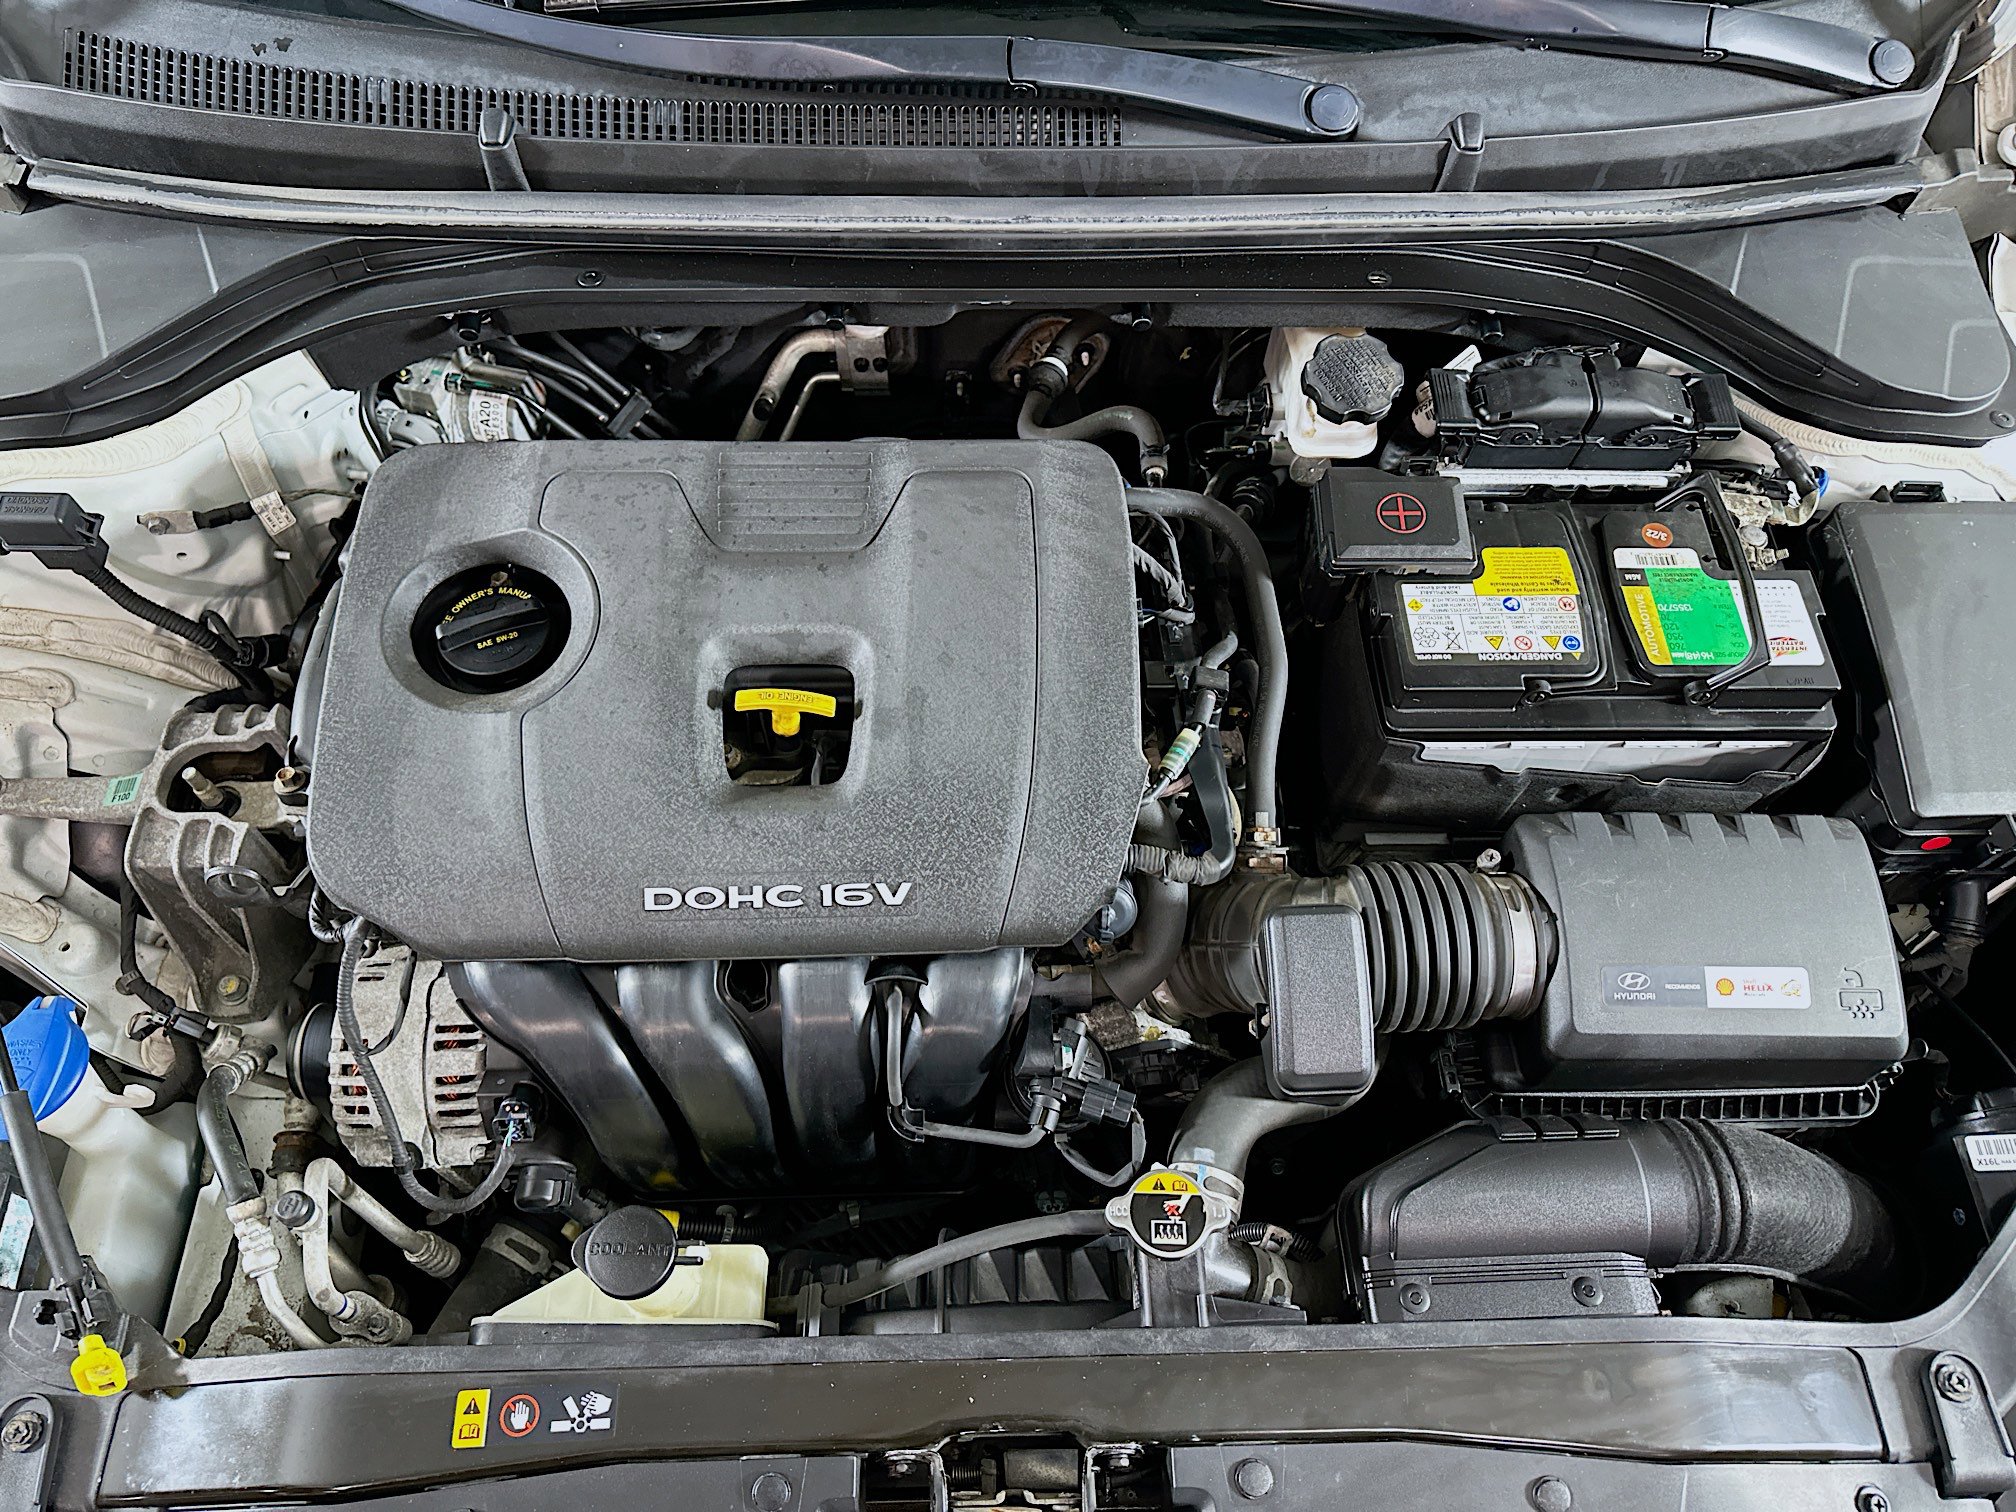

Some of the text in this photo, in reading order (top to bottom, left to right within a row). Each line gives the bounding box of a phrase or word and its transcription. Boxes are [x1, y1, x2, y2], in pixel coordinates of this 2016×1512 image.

[480, 401, 491, 428] A20
[1645, 528, 1668, 541] 3/22
[1624, 573, 1642, 581] AGM
[451, 587, 494, 613] OWNER'S
[1657, 603, 1694, 612] 1355770
[1634, 593, 1661, 658] AUTOMOTIVE
[477, 631, 519, 650] SAE 5W-20
[1666, 632, 1684, 640] 950
[1669, 642, 1686, 651] 760
[1478, 652, 1563, 661] DANGER/POISON
[758, 692, 814, 703] ENGINE OIL
[111, 792, 131, 803] F100
[643, 881, 913, 911] DOHC 16V
[1743, 983, 1774, 992] HELIX
[1613, 992, 1656, 1001] HYUNDAI
[1976, 1158, 2001, 1166] X16L
[1109, 1205, 1129, 1217] HCC
[590, 1242, 673, 1256] COOLANT
